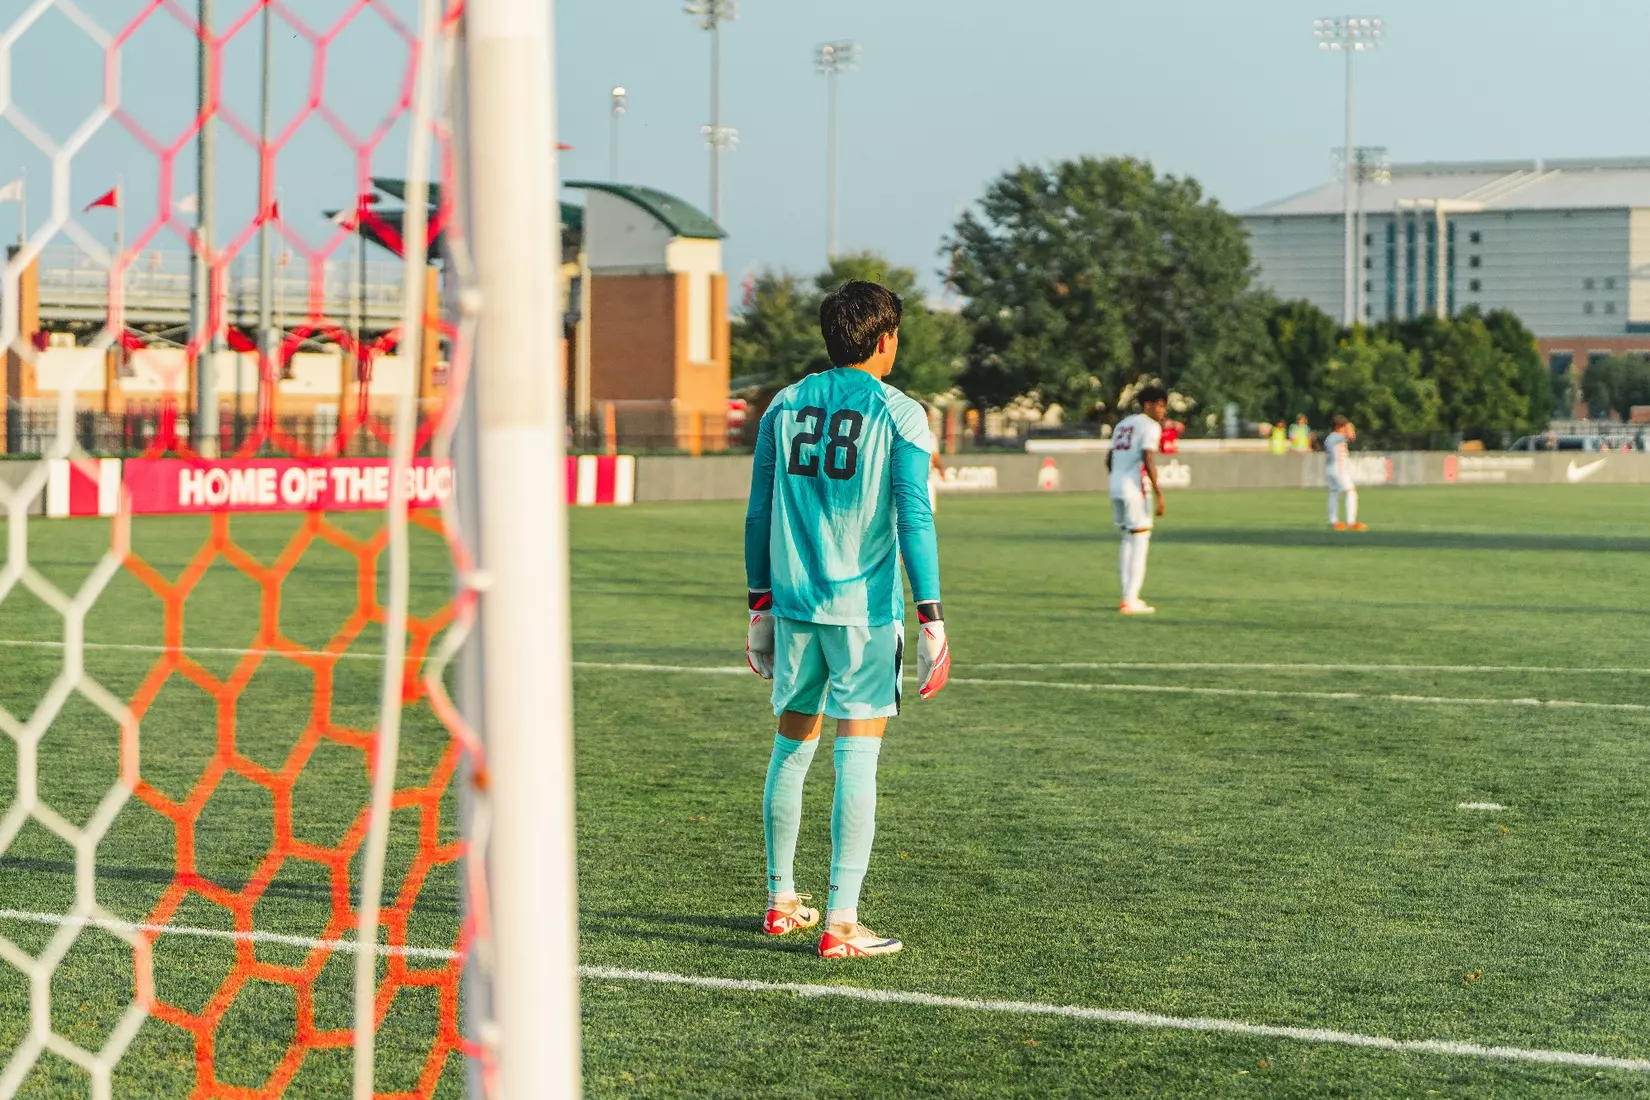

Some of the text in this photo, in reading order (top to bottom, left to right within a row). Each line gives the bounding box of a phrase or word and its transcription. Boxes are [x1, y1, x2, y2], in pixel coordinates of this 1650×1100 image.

[787, 405, 864, 481] 28
[178, 465, 455, 506] HOME OF THE BUC
